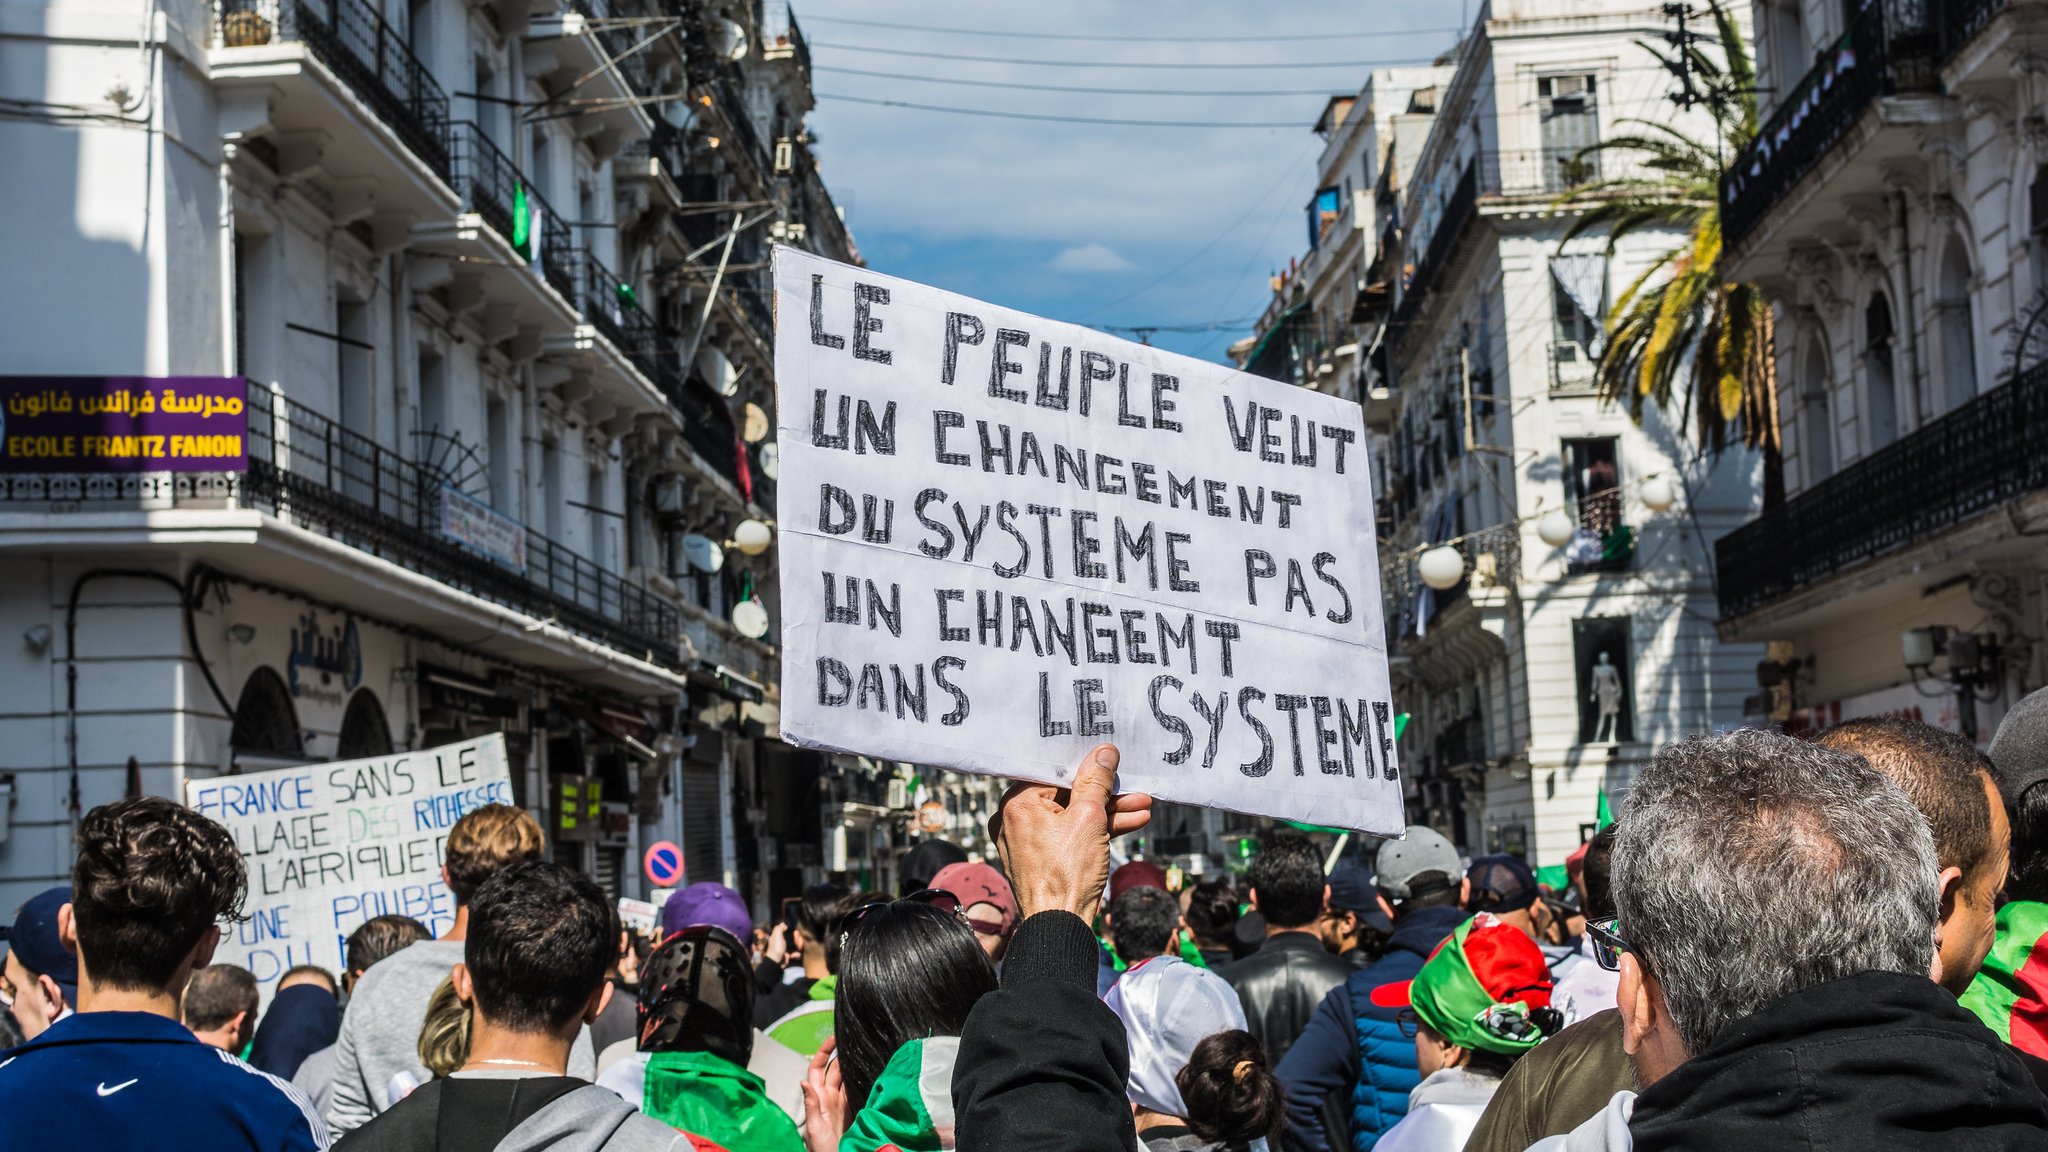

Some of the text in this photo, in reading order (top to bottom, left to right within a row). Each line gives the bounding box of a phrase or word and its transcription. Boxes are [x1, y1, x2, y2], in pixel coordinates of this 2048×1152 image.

[9, 389, 243, 418] مدرسة فرانس فانون
[810, 274, 1356, 474] LE PEUPLE VEUT
[9, 435, 241, 458] ECOLE FRANTZ FANON
[812, 388, 1302, 528] UN CHANGEMENT
[818, 483, 1353, 624] DU SYSTEME PAS
[822, 571, 1241, 677] UN CHANGEMT
[816, 656, 1399, 781] DANS LE SYSTEME
[199, 747, 476, 818] FRANCE SANS LE
[347, 804, 400, 843] DES
[261, 839, 428, 895] L'AFRIQUE
[239, 904, 290, 946] UNE
[332, 880, 451, 930] POUBE
